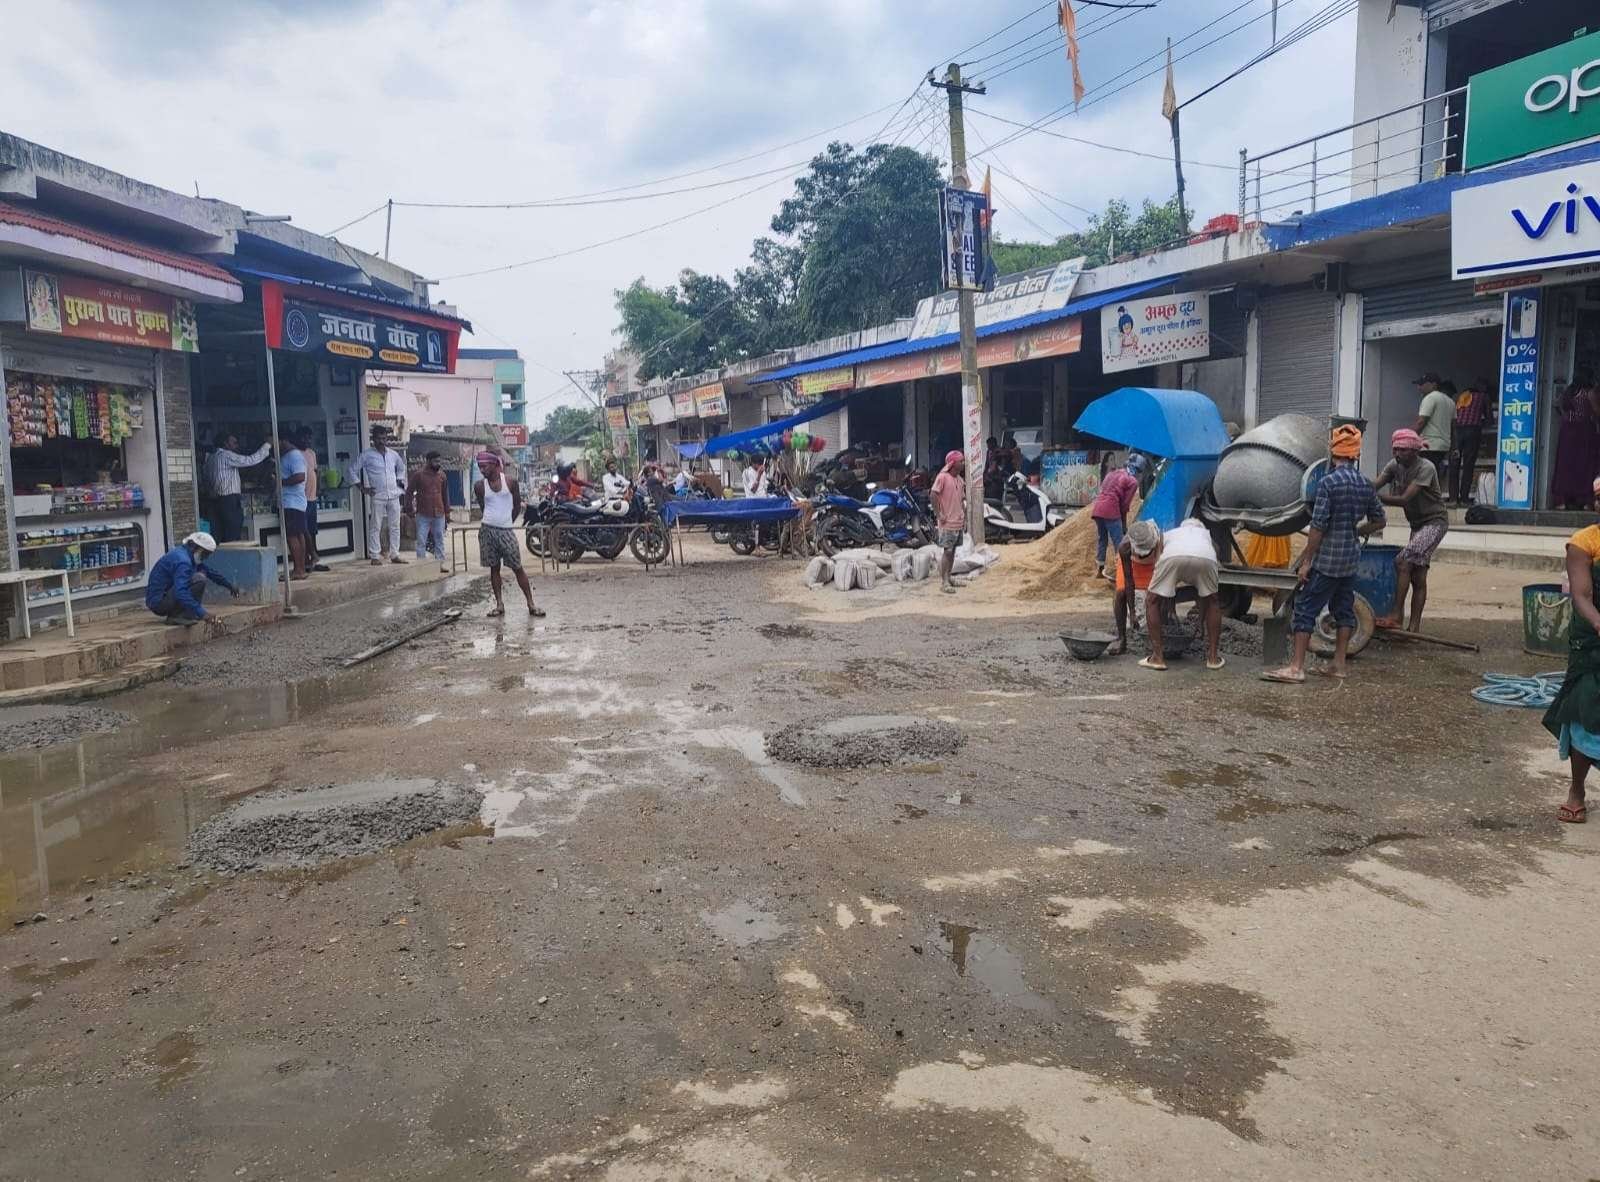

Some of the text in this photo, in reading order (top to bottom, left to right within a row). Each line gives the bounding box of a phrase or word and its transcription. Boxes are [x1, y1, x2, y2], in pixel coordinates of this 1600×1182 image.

[64, 295, 104, 326] पुराना
[107, 304, 132, 328] पान
[135, 309, 169, 336] दुकान
[1179, 300, 1195, 317] दूध
[318, 313, 419, 351] जनता वॉच
[1507, 343, 1536, 358] 0%
[1505, 379, 1534, 393] दर पे
[1504, 399, 1533, 416] लोन
[1512, 419, 1523, 432] पे
[1502, 434, 1533, 455] फोन
